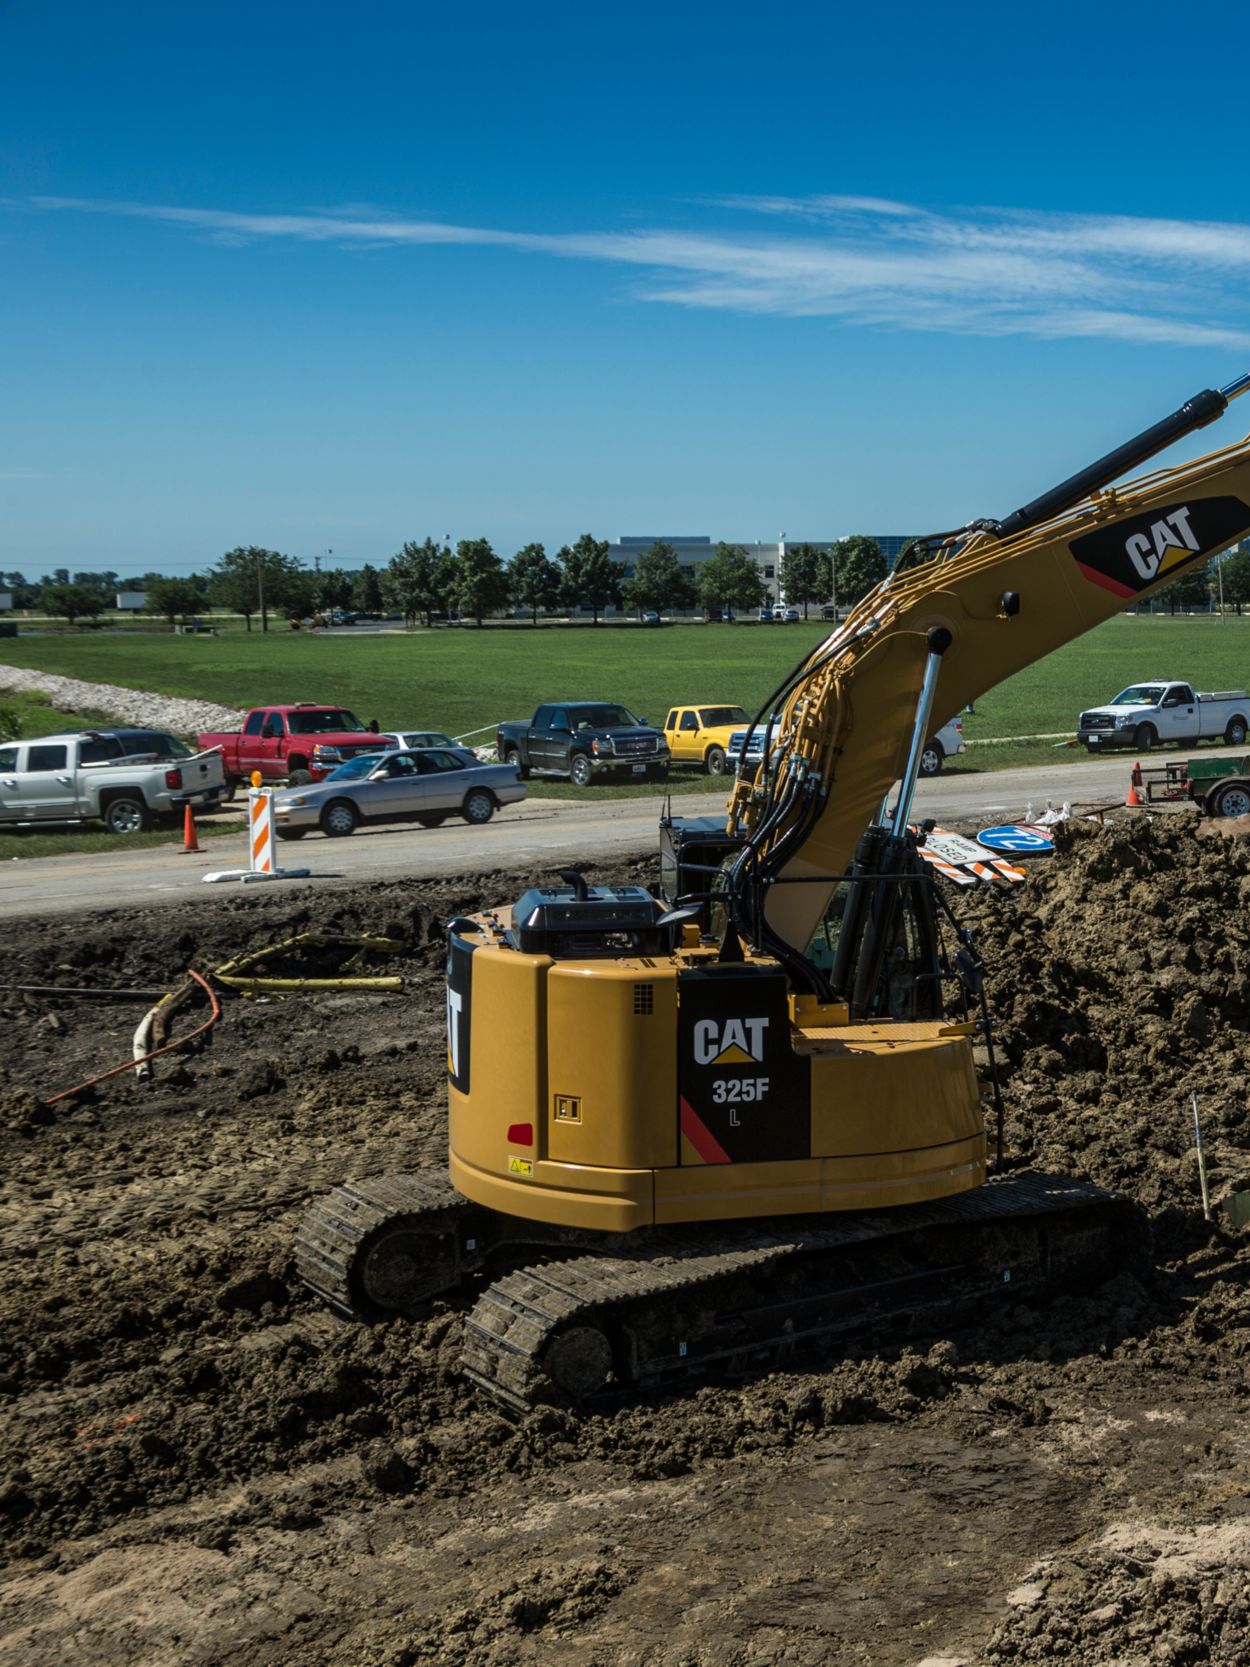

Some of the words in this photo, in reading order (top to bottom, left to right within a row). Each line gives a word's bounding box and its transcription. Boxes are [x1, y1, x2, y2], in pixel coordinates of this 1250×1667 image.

[1125, 506, 1201, 580] CAT
[926, 836, 968, 861] CLOSED
[947, 838, 977, 853] RAMP
[985, 828, 1045, 849] 72
[693, 1017, 770, 1065] CAT
[712, 1077, 770, 1105] 325F
[729, 1108, 741, 1127] L
